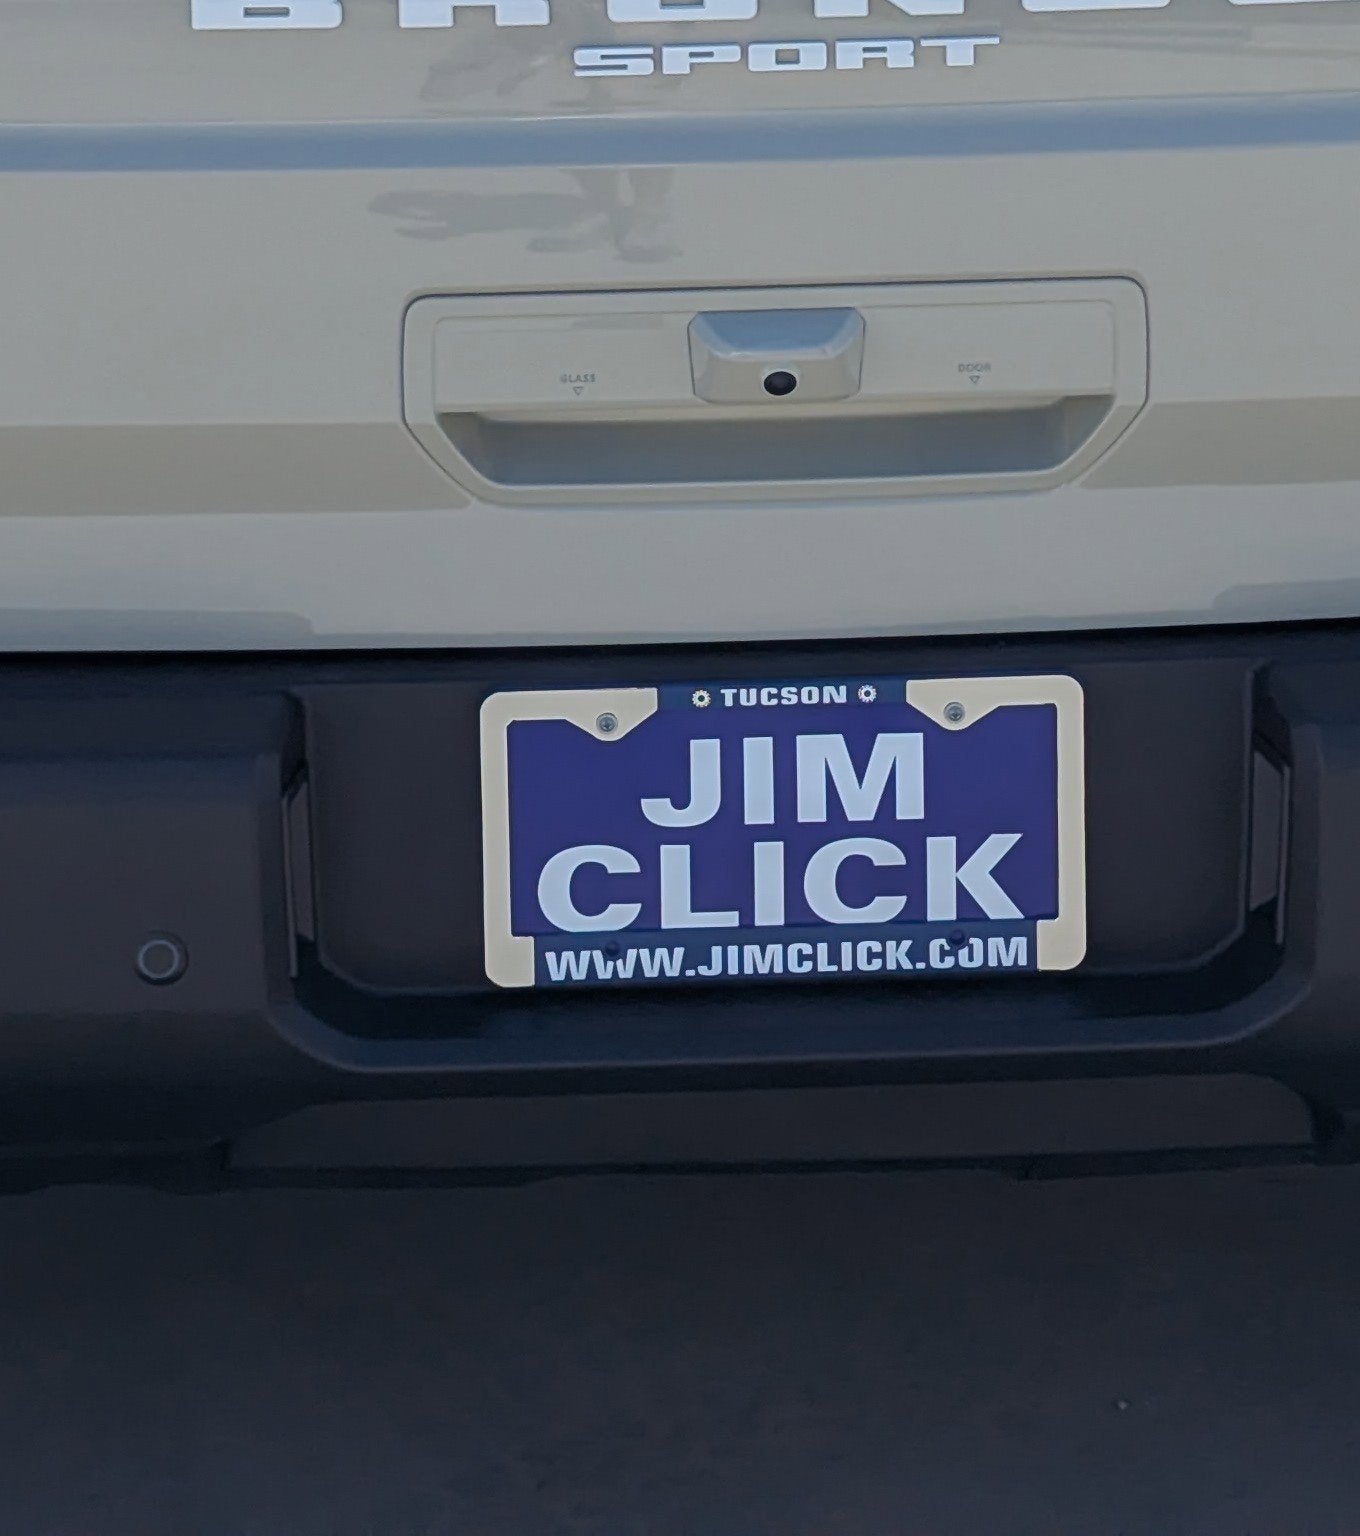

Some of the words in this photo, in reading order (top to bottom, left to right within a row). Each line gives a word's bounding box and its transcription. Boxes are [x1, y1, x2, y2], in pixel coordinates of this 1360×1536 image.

[572, 35, 1001, 78] SPORT
[559, 373, 596, 383] GLASS
[958, 362, 992, 373] DOOR
[719, 685, 848, 707] TUCSON
[640, 732, 926, 828] JIM
[536, 833, 1026, 933] CLICK
[544, 936, 1029, 981] WWW.JIMCLICK.COM
